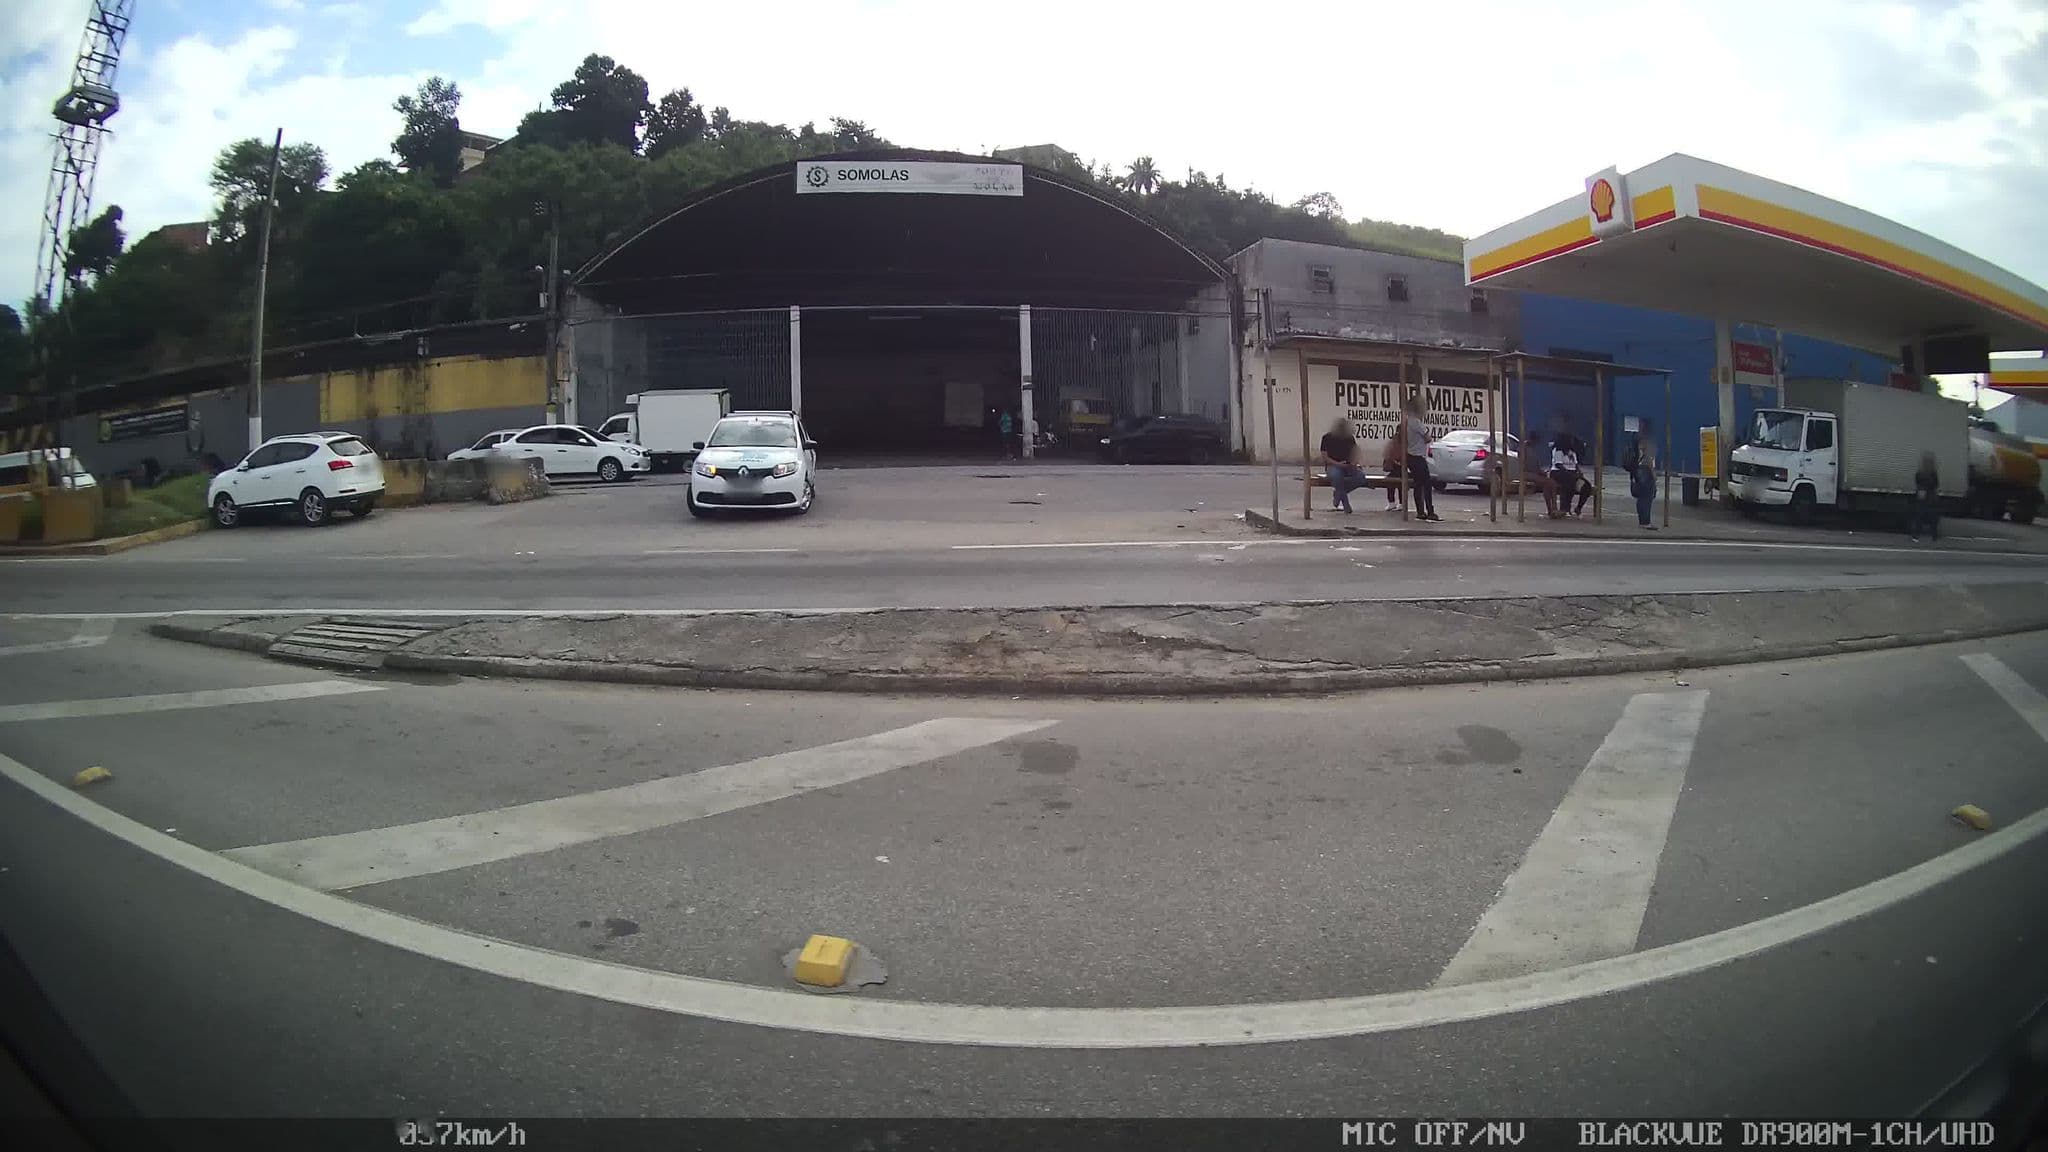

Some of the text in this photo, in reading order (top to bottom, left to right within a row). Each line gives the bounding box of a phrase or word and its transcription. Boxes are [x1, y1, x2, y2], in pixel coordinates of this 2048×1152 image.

[837, 169, 909, 181] SOMOLAS
[1335, 382, 1391, 408] POSTO
[1425, 387, 1483, 413] MOLAS
[1347, 409, 1478, 428] EMBUCHAMEN MANGA DE EIXO
